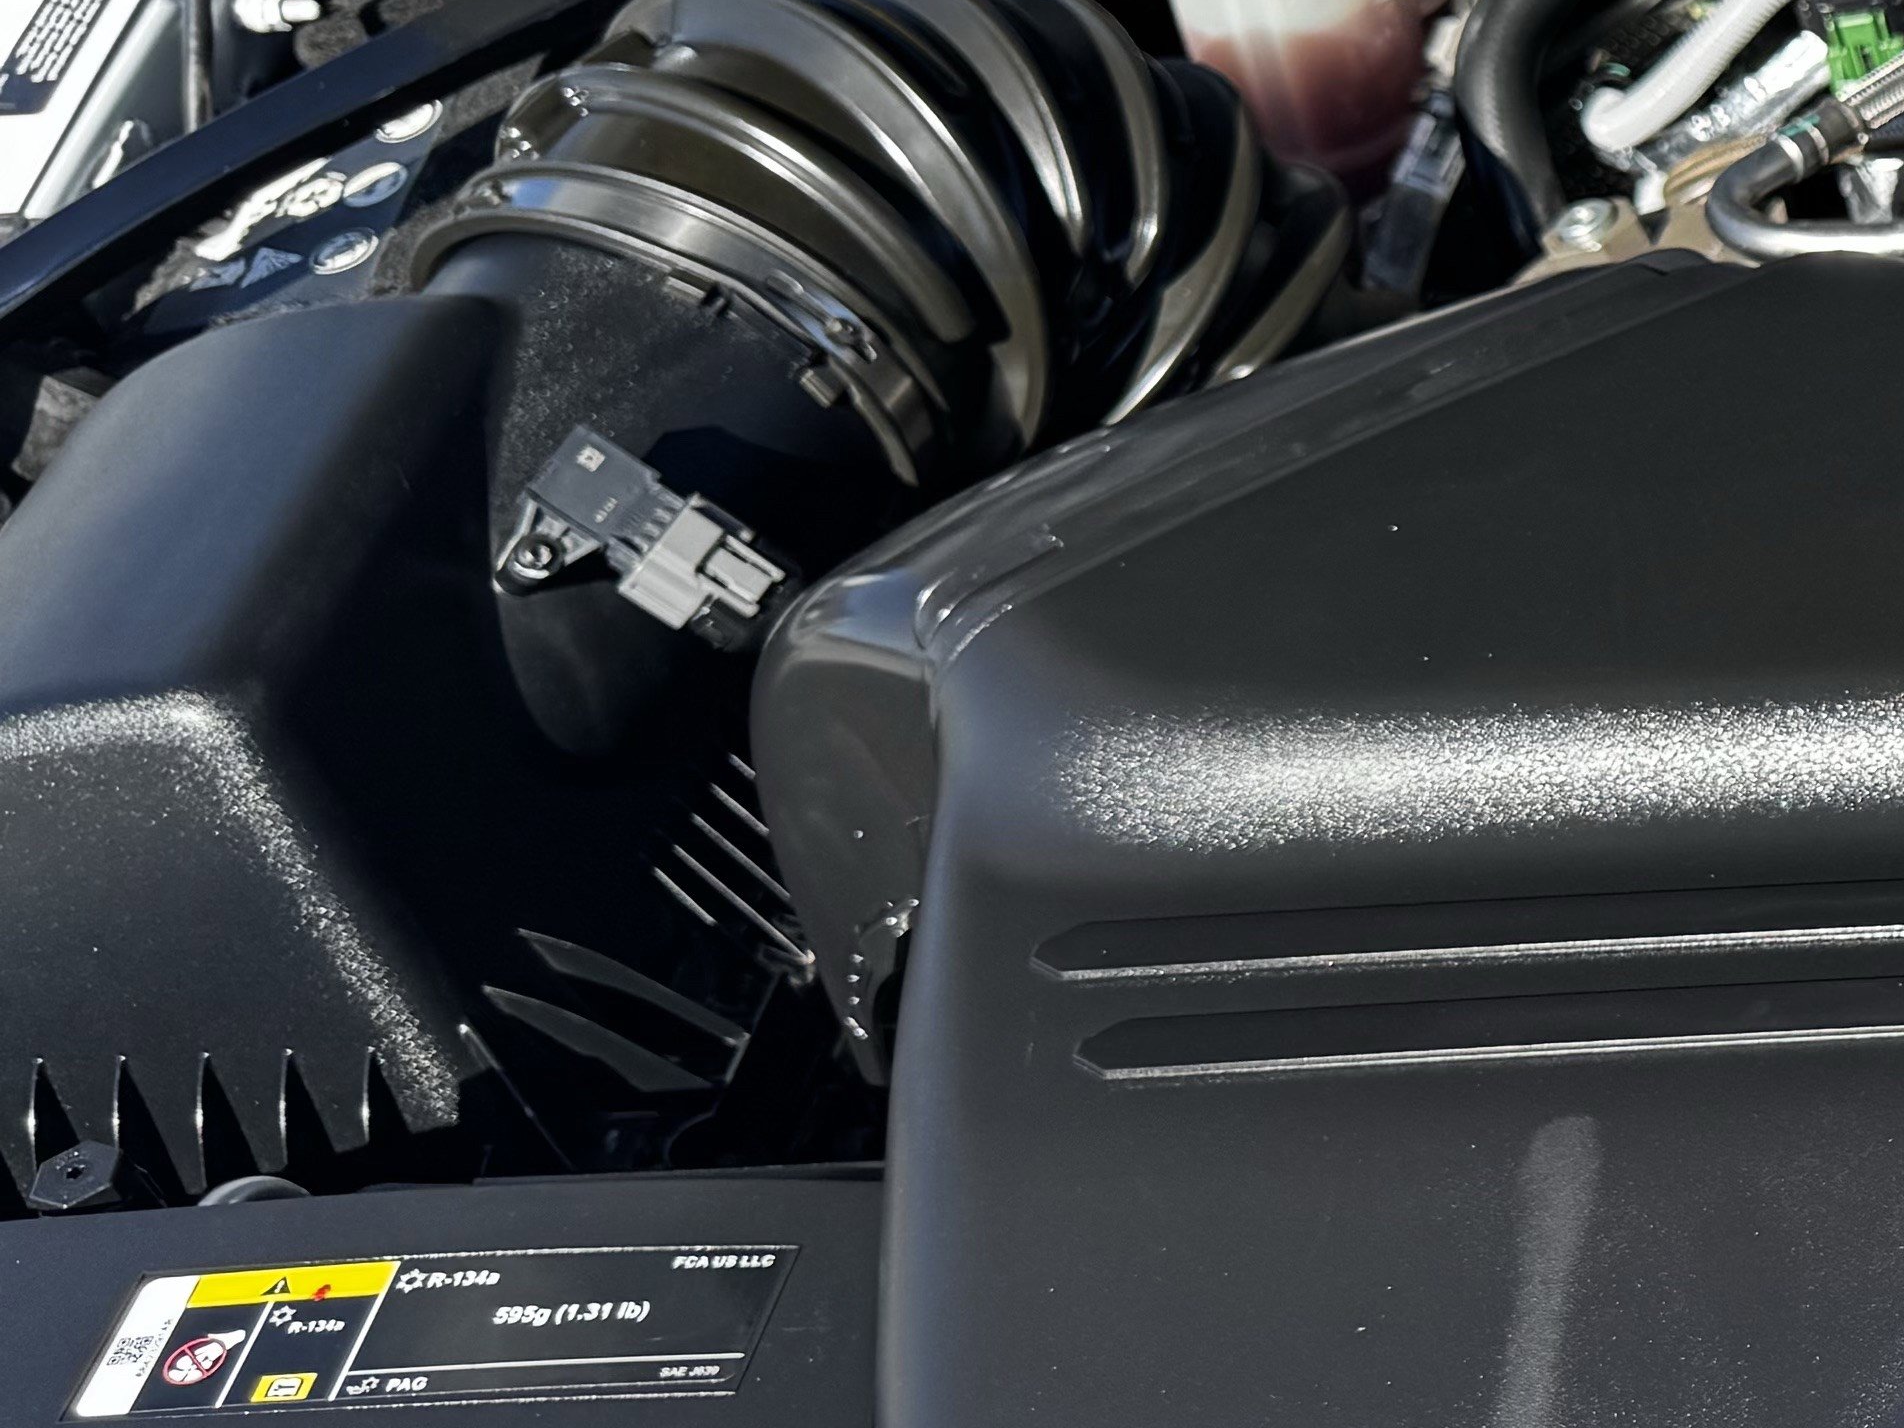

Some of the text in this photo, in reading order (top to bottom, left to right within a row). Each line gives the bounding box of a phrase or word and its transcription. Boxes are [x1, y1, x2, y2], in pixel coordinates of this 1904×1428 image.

[672, 1254, 776, 1270] FCA US LLC
[426, 1270, 501, 1289] R-134a
[493, 1300, 651, 1327] 595g (1.31 lb)
[385, 1376, 429, 1393] PAG
